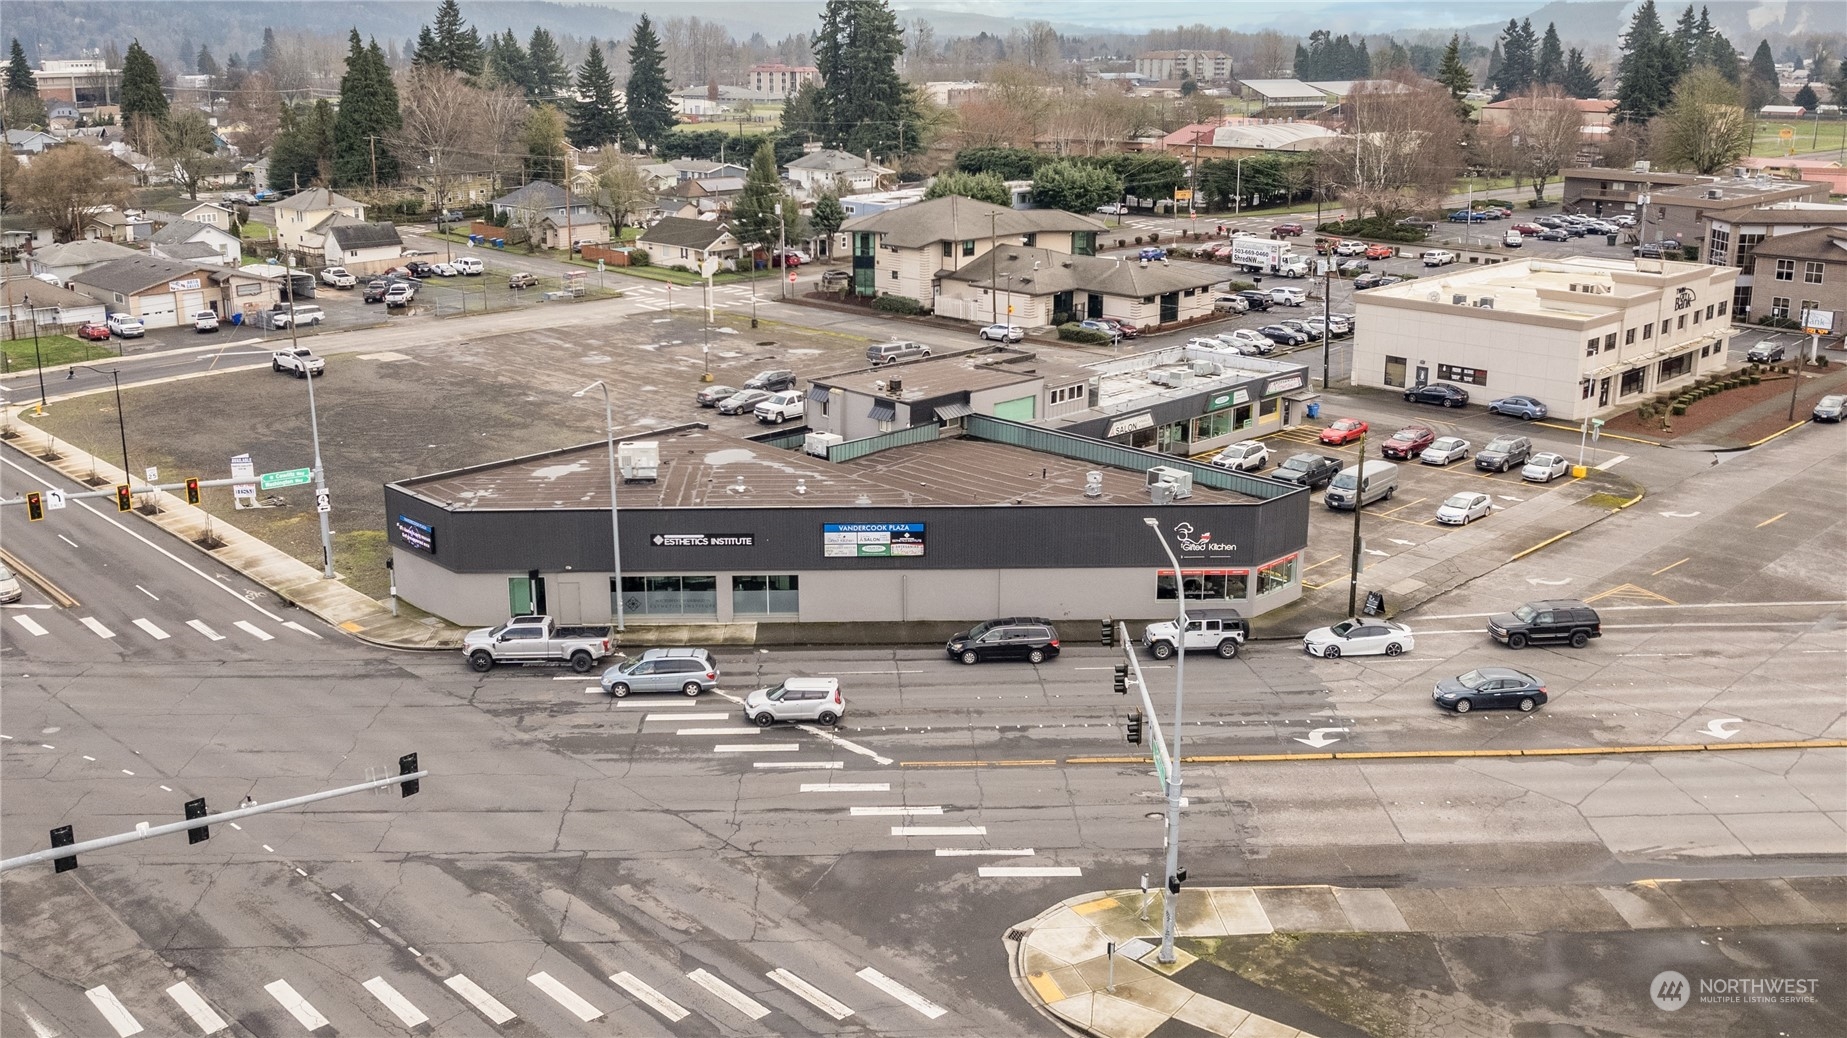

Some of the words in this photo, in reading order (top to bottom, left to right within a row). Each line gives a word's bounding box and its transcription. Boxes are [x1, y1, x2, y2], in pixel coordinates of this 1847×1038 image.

[1674, 294, 1691, 311] Bank
[1115, 422, 1137, 435] SALON
[664, 538, 709, 546] ESTHETICS
[710, 537, 753, 545] INSTITUTE
[1208, 543, 1237, 551] Kitchen
